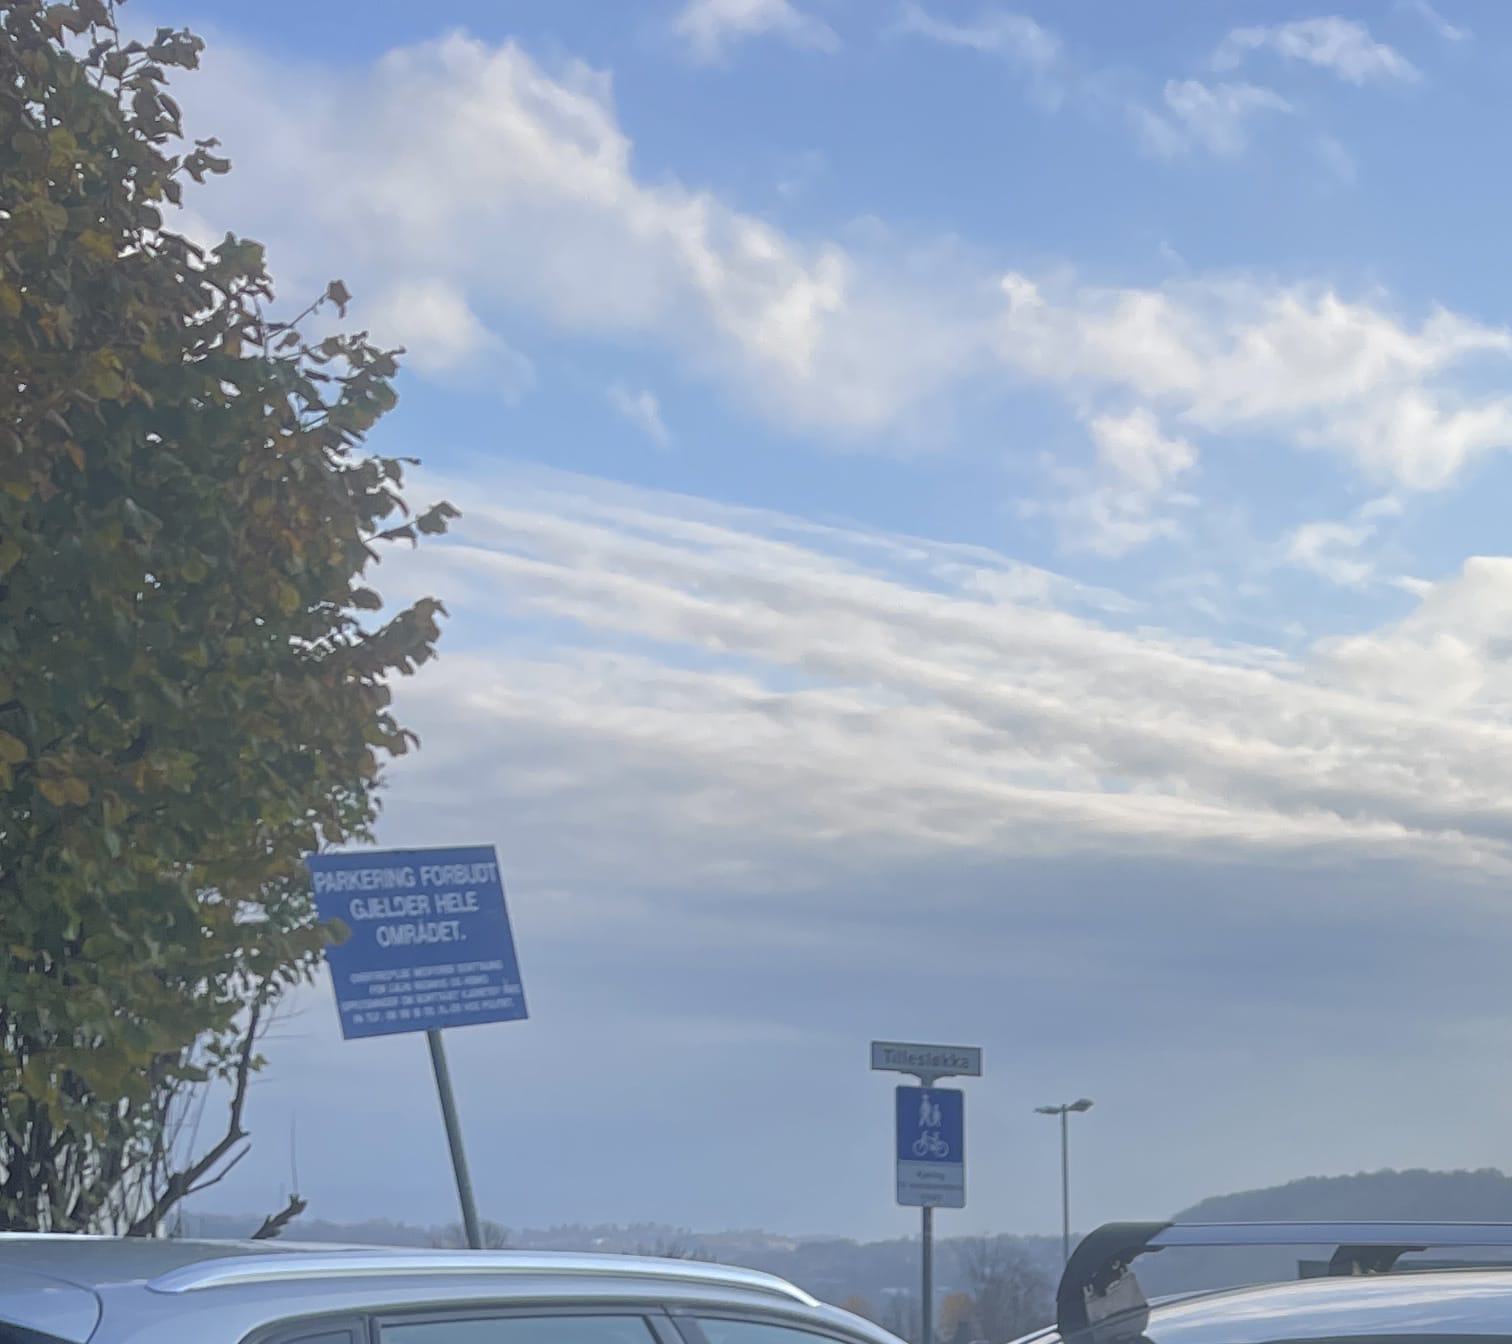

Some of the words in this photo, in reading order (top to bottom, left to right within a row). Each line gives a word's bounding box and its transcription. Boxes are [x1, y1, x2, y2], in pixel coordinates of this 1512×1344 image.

[313, 867, 415, 893] PARKERING
[420, 862, 499, 888] FORBUDT
[350, 894, 431, 920] GJELDER
[435, 891, 480, 914] HELE
